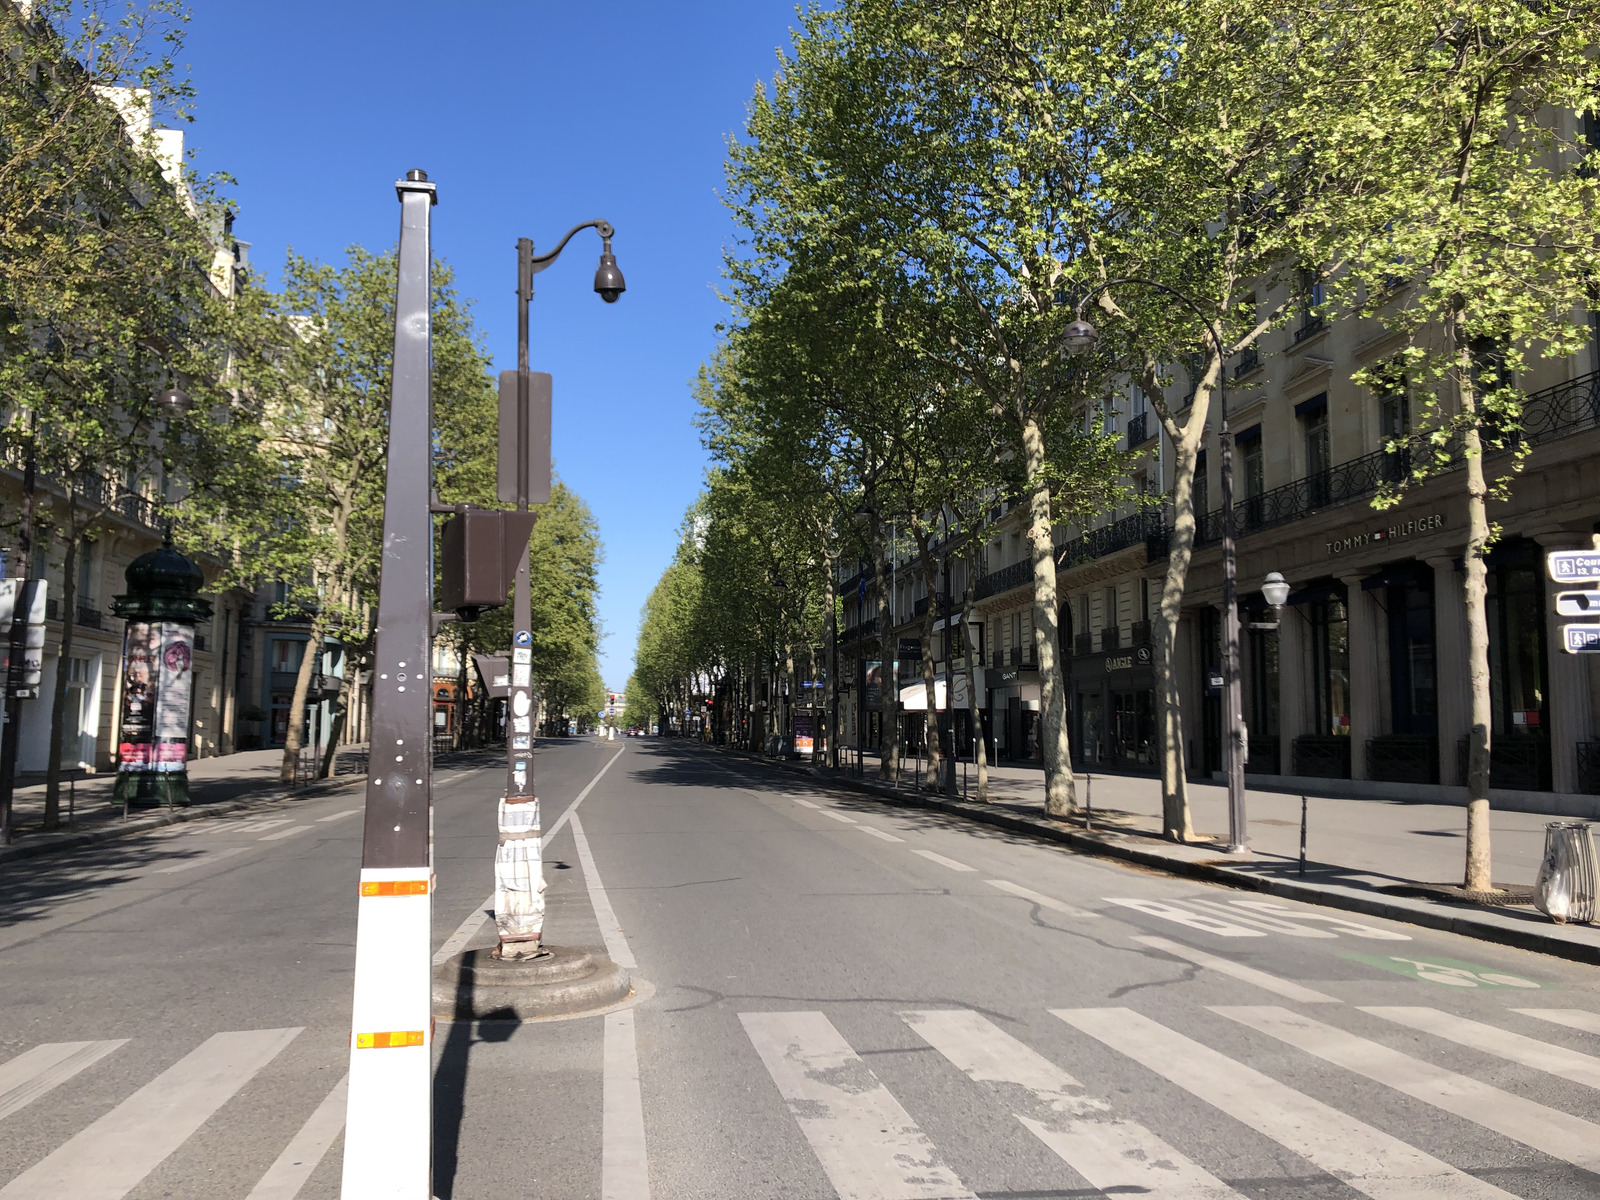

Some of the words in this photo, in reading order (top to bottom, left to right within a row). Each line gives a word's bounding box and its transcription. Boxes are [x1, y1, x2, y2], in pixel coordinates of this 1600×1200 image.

[1326, 533, 1370, 555] TOMMY
[1388, 514, 1443, 539] HILFIGER
[1002, 671, 1017, 681] GANT
[1112, 656, 1133, 670] AIGLE
[1101, 897, 1413, 941] BUS
